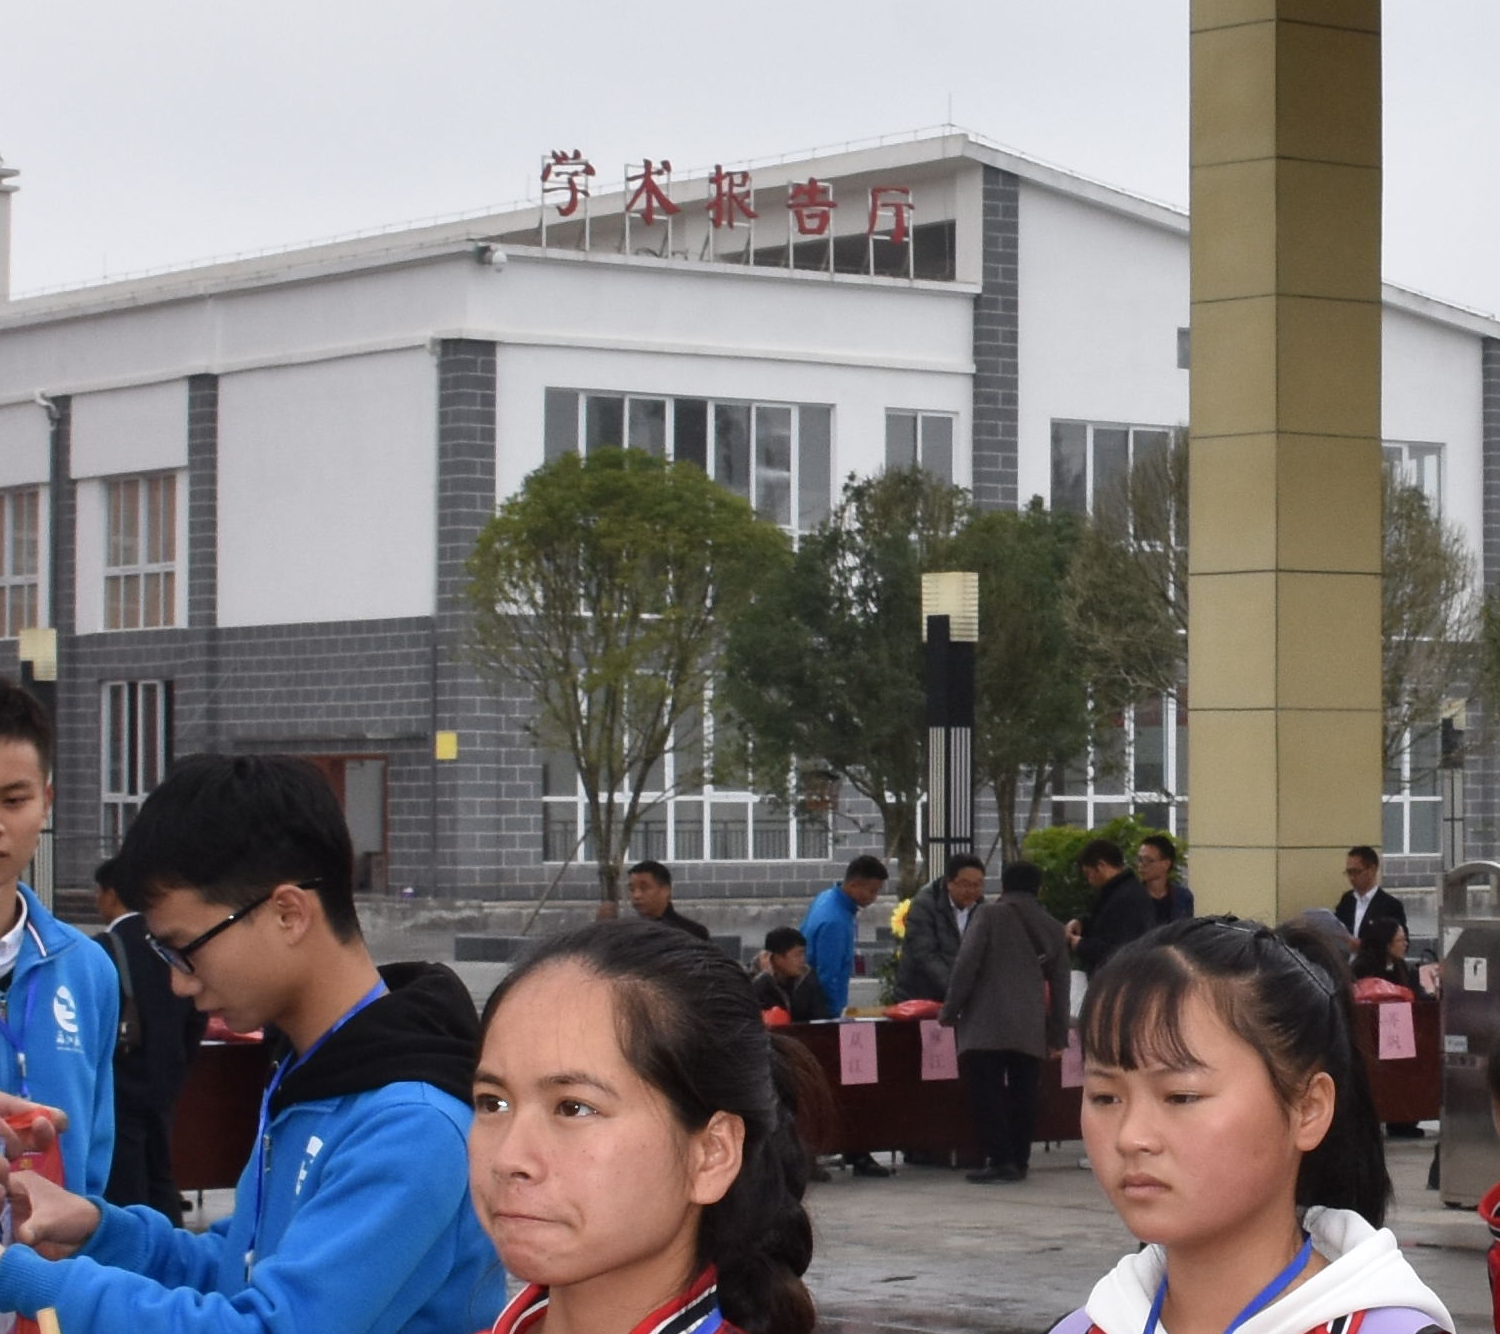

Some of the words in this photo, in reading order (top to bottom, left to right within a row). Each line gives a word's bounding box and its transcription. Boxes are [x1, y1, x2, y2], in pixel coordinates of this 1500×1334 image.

[540, 148, 915, 245] 学术报告厅
